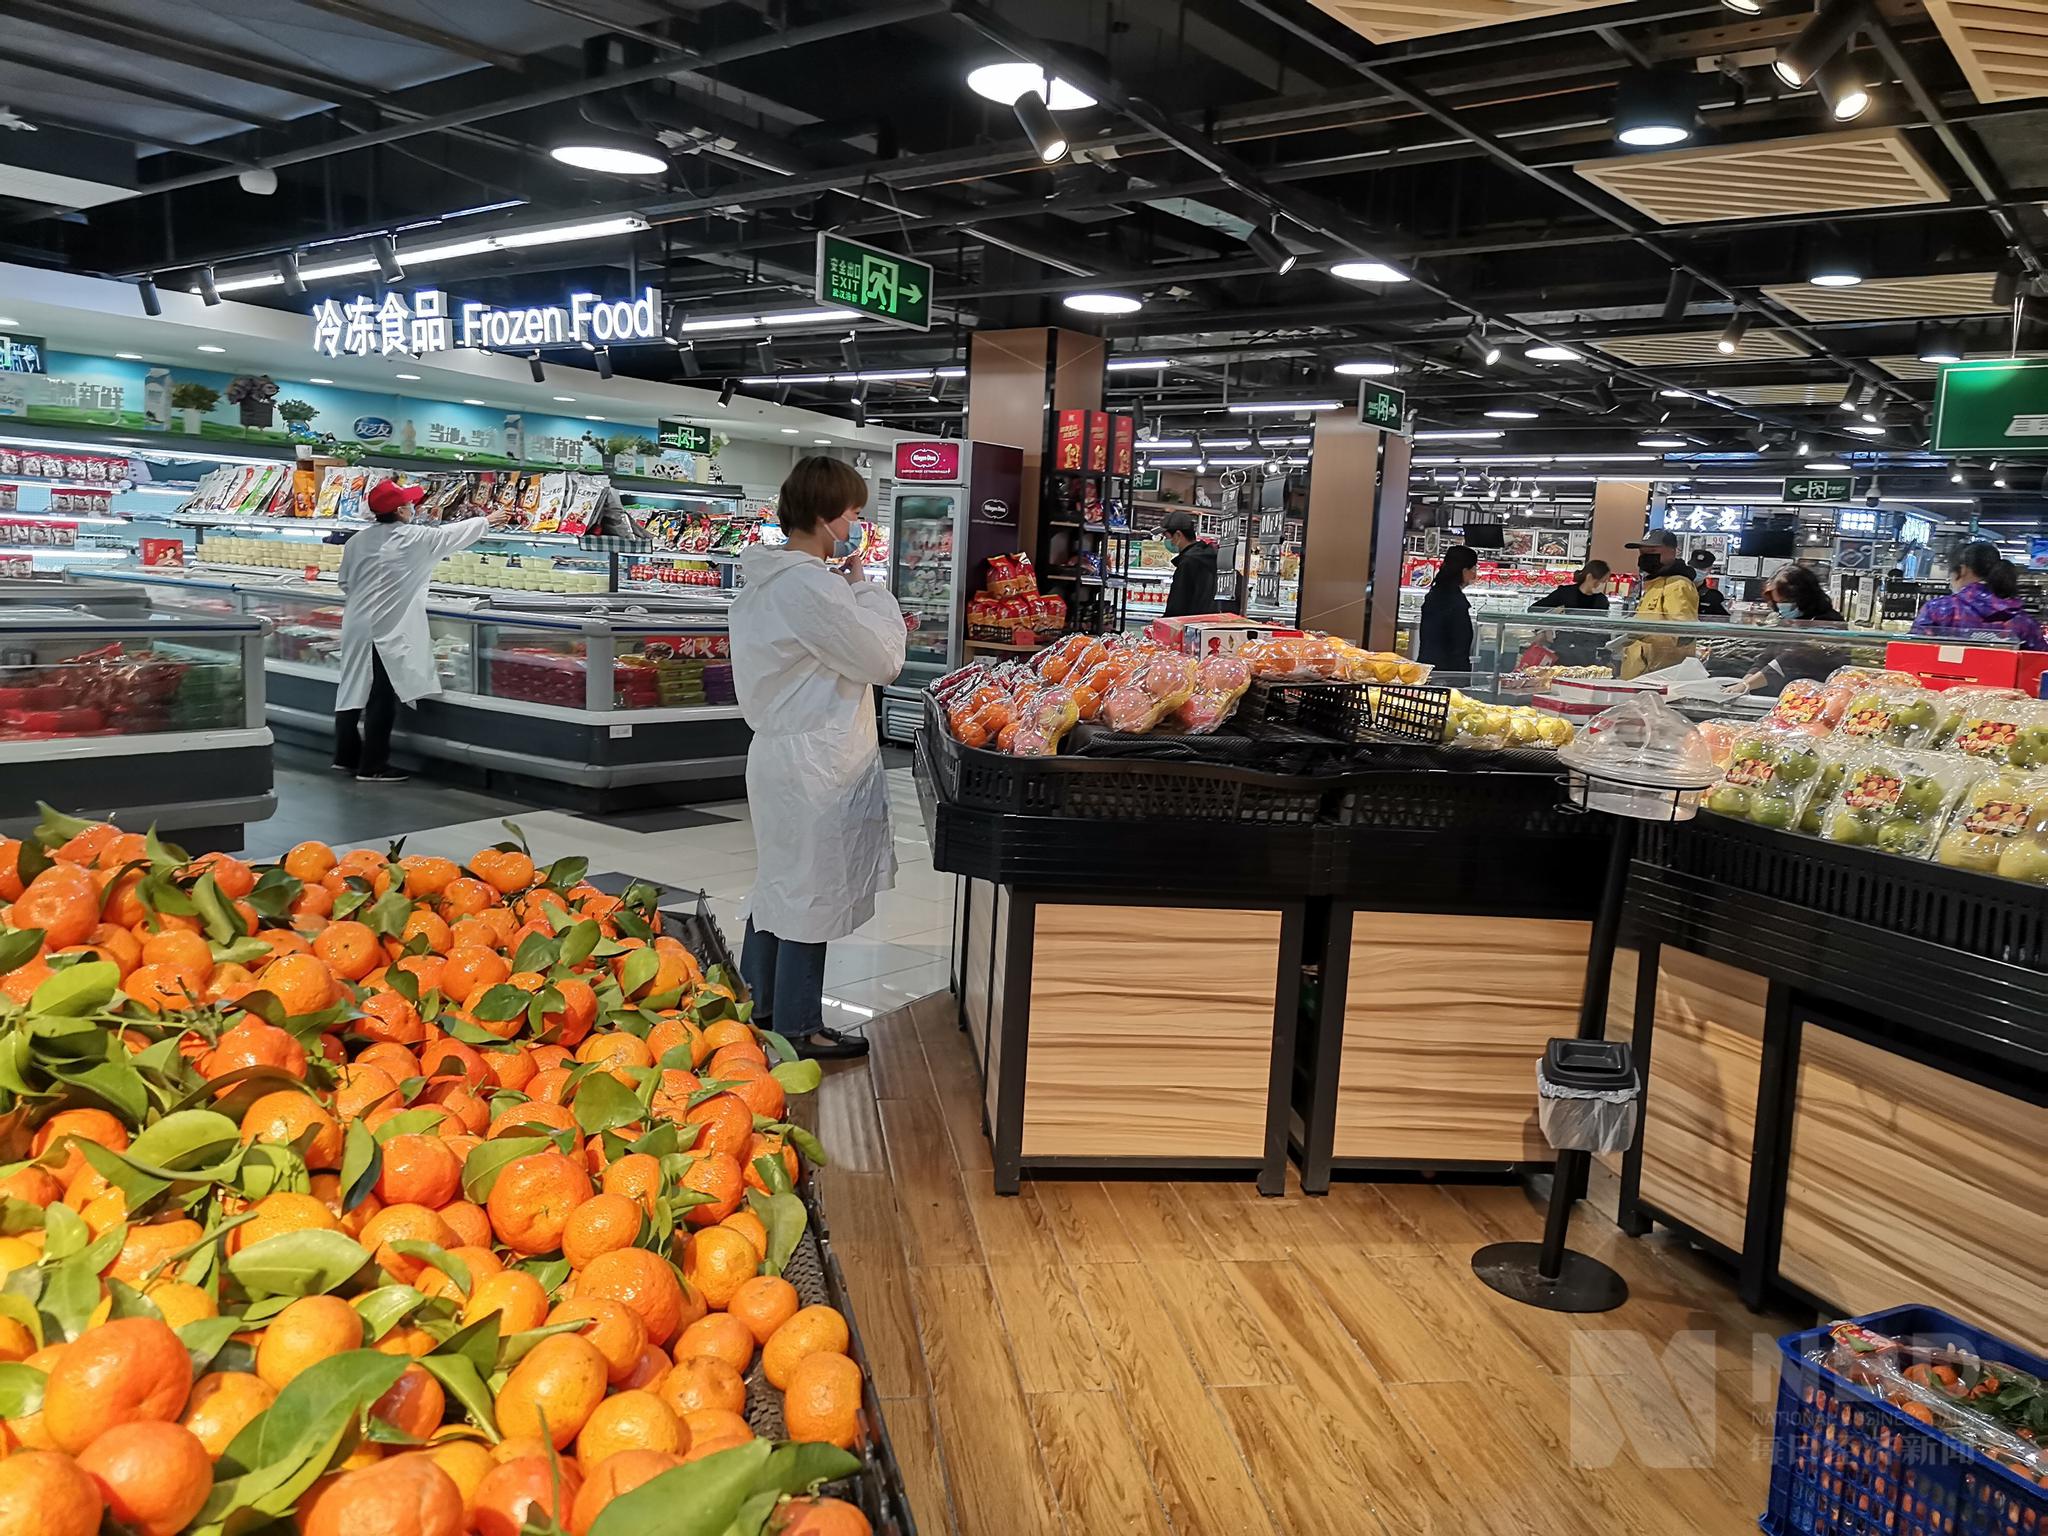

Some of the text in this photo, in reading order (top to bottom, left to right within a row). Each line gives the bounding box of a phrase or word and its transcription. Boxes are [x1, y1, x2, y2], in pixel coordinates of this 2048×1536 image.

[831, 258, 861, 279] 安全出口
[832, 275, 859, 291] EXIT
[313, 291, 450, 358] 冷冻食品
[463, 287, 654, 348] Frozen Food
